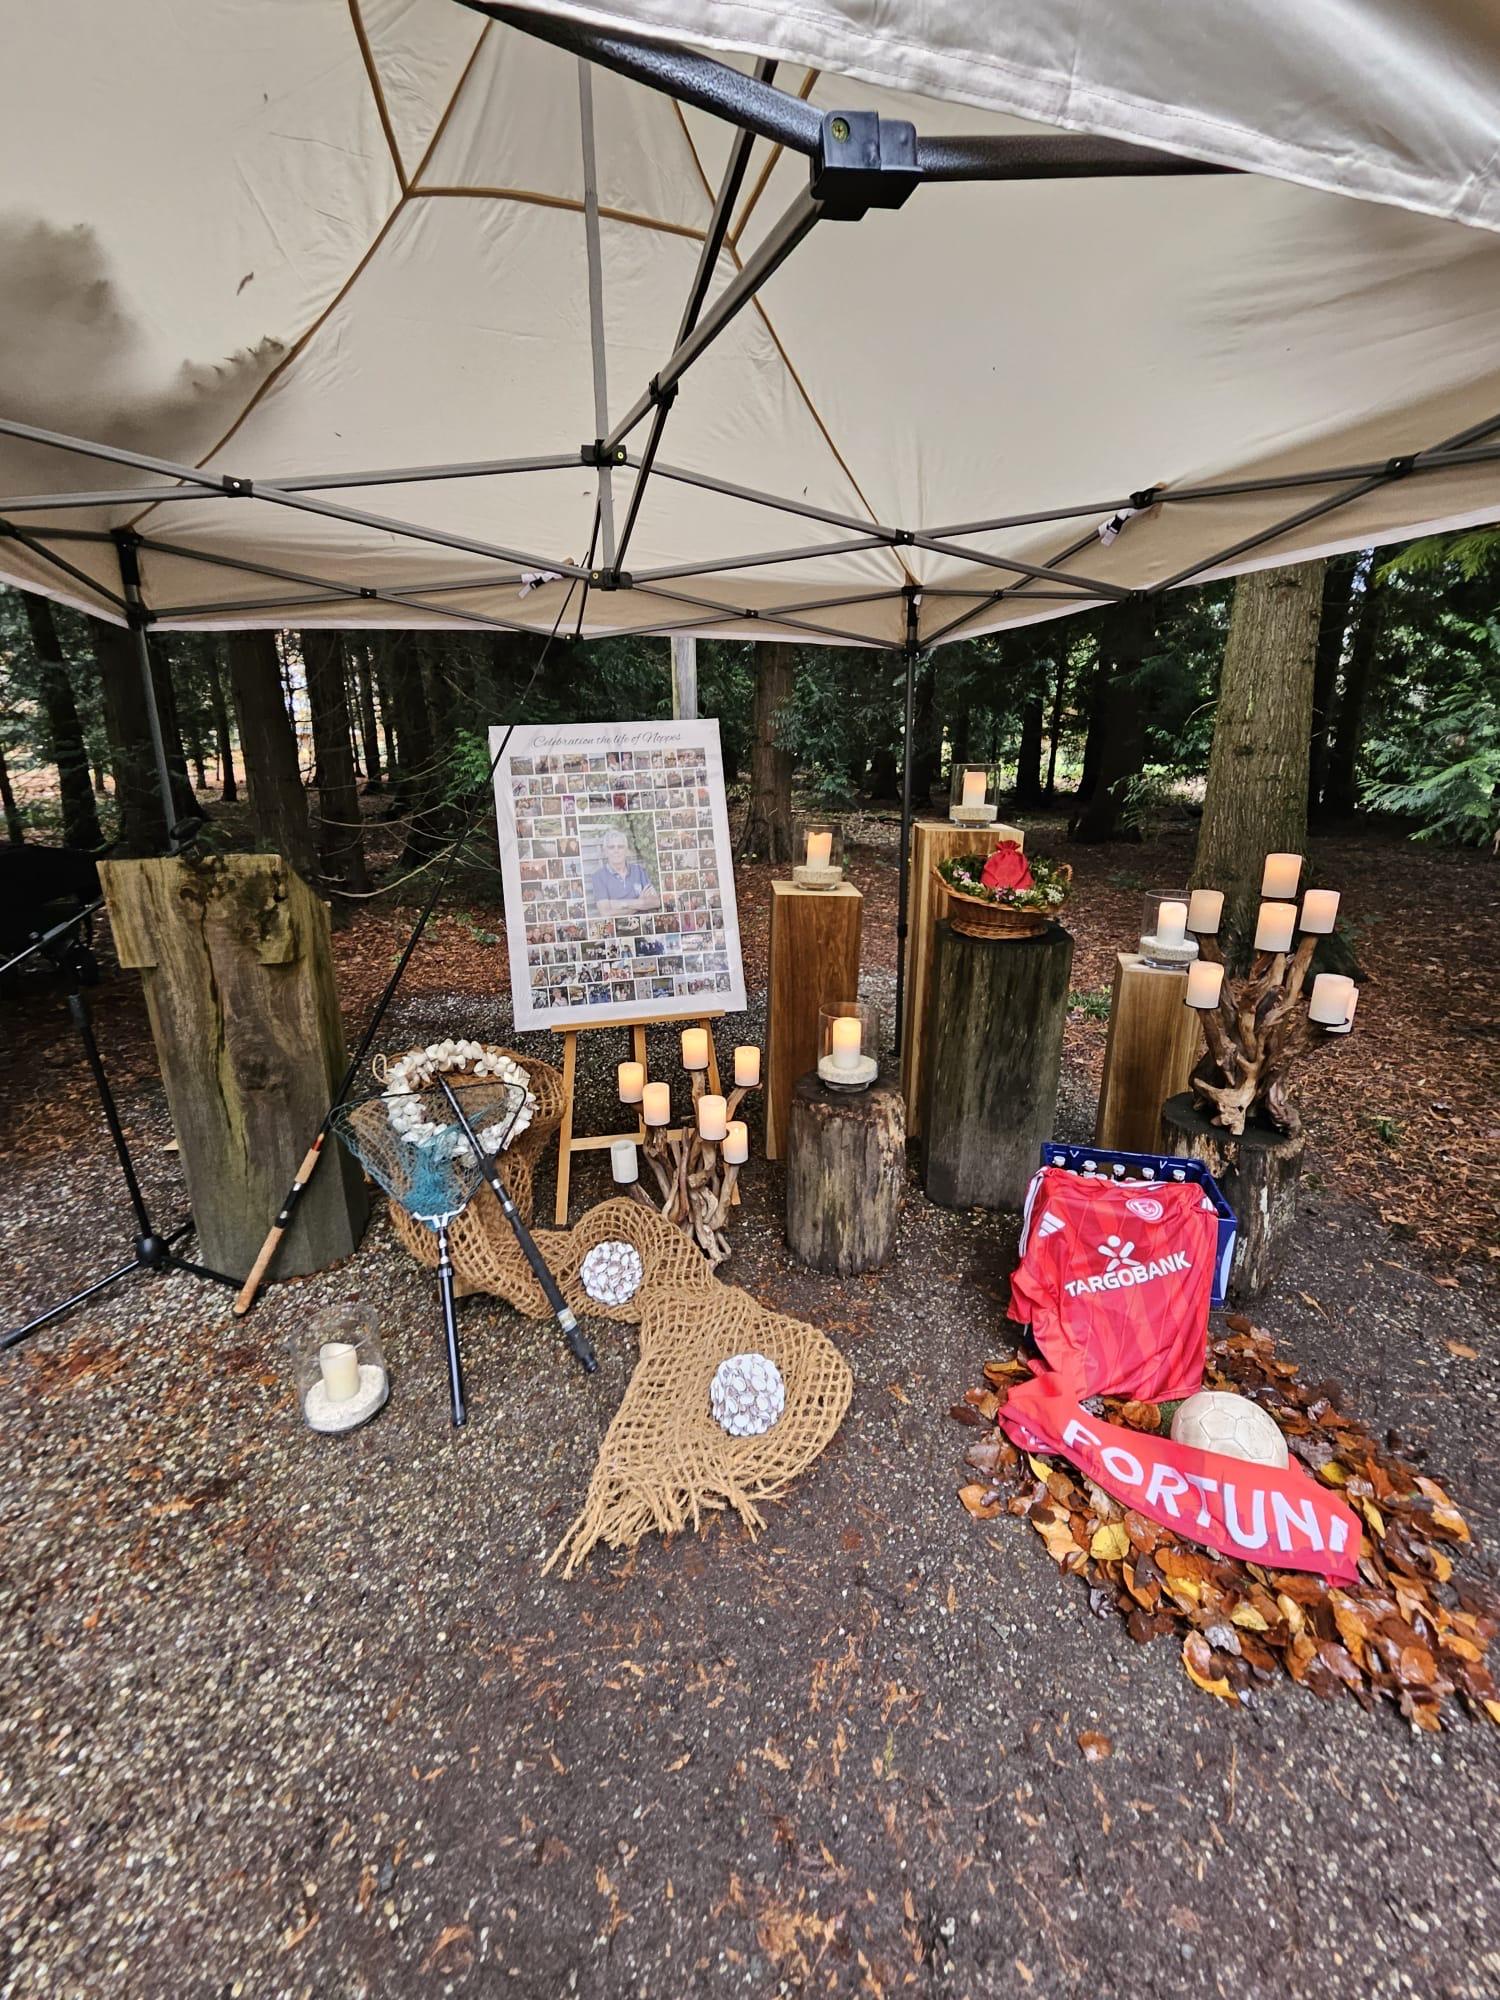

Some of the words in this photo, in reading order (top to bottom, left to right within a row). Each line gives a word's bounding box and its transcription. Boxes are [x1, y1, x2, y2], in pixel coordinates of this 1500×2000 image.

[533, 735, 593, 748] Celebration
[596, 735, 611, 745] the
[613, 733, 630, 746] life
[631, 733, 642, 745] of
[1064, 1250, 1192, 1298] TARGOBANK
